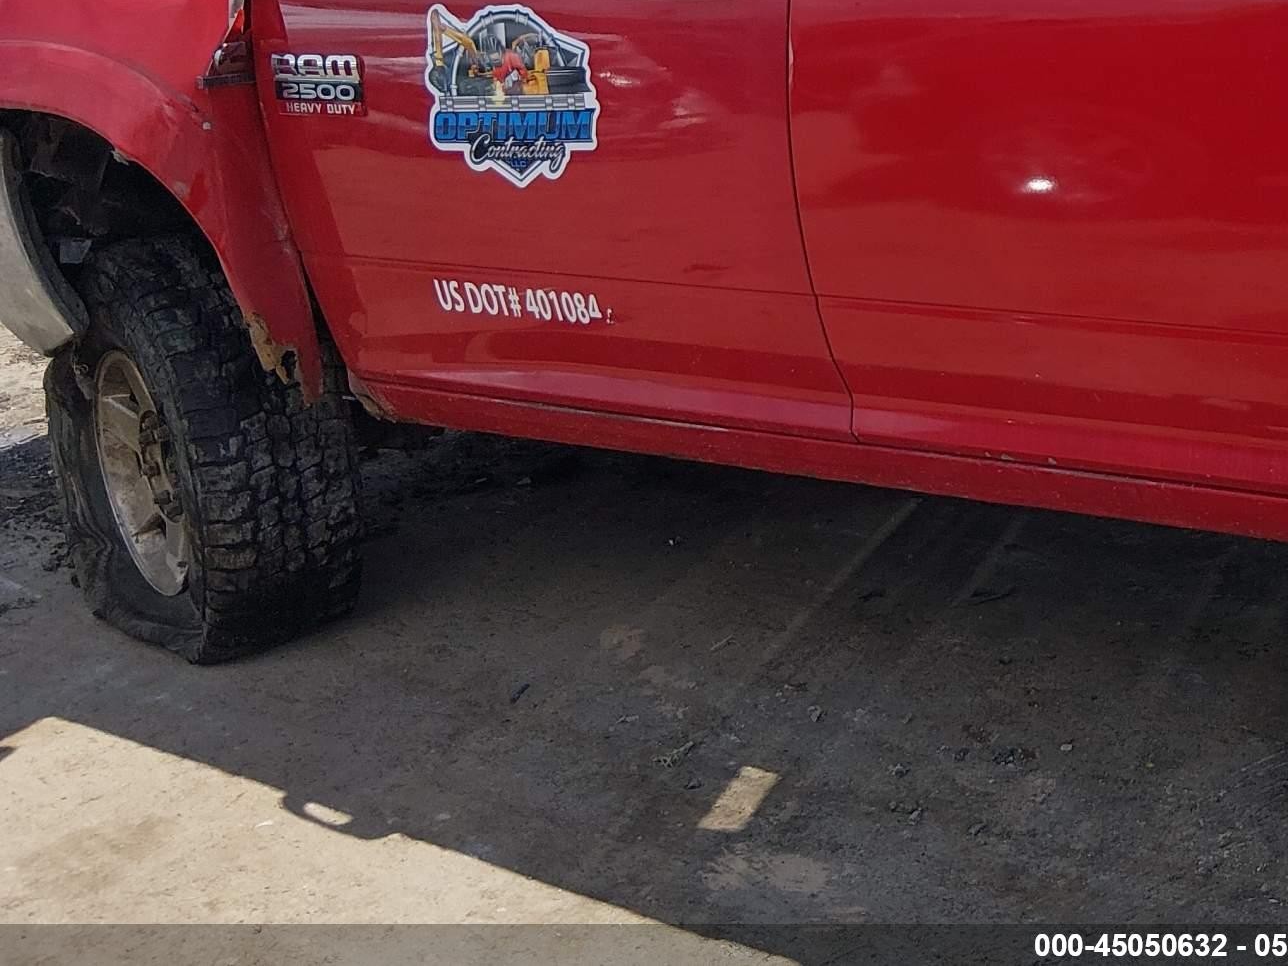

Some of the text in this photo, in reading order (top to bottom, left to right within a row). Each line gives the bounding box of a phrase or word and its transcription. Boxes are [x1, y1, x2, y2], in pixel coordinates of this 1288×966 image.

[271, 53, 360, 83] RAM
[282, 82, 356, 101] 2500
[286, 102, 356, 115] HEAVY DUTY
[435, 110, 592, 141] OPTIMUM
[471, 133, 566, 171] Contracting
[433, 279, 465, 312] US
[463, 282, 521, 318] DOT#
